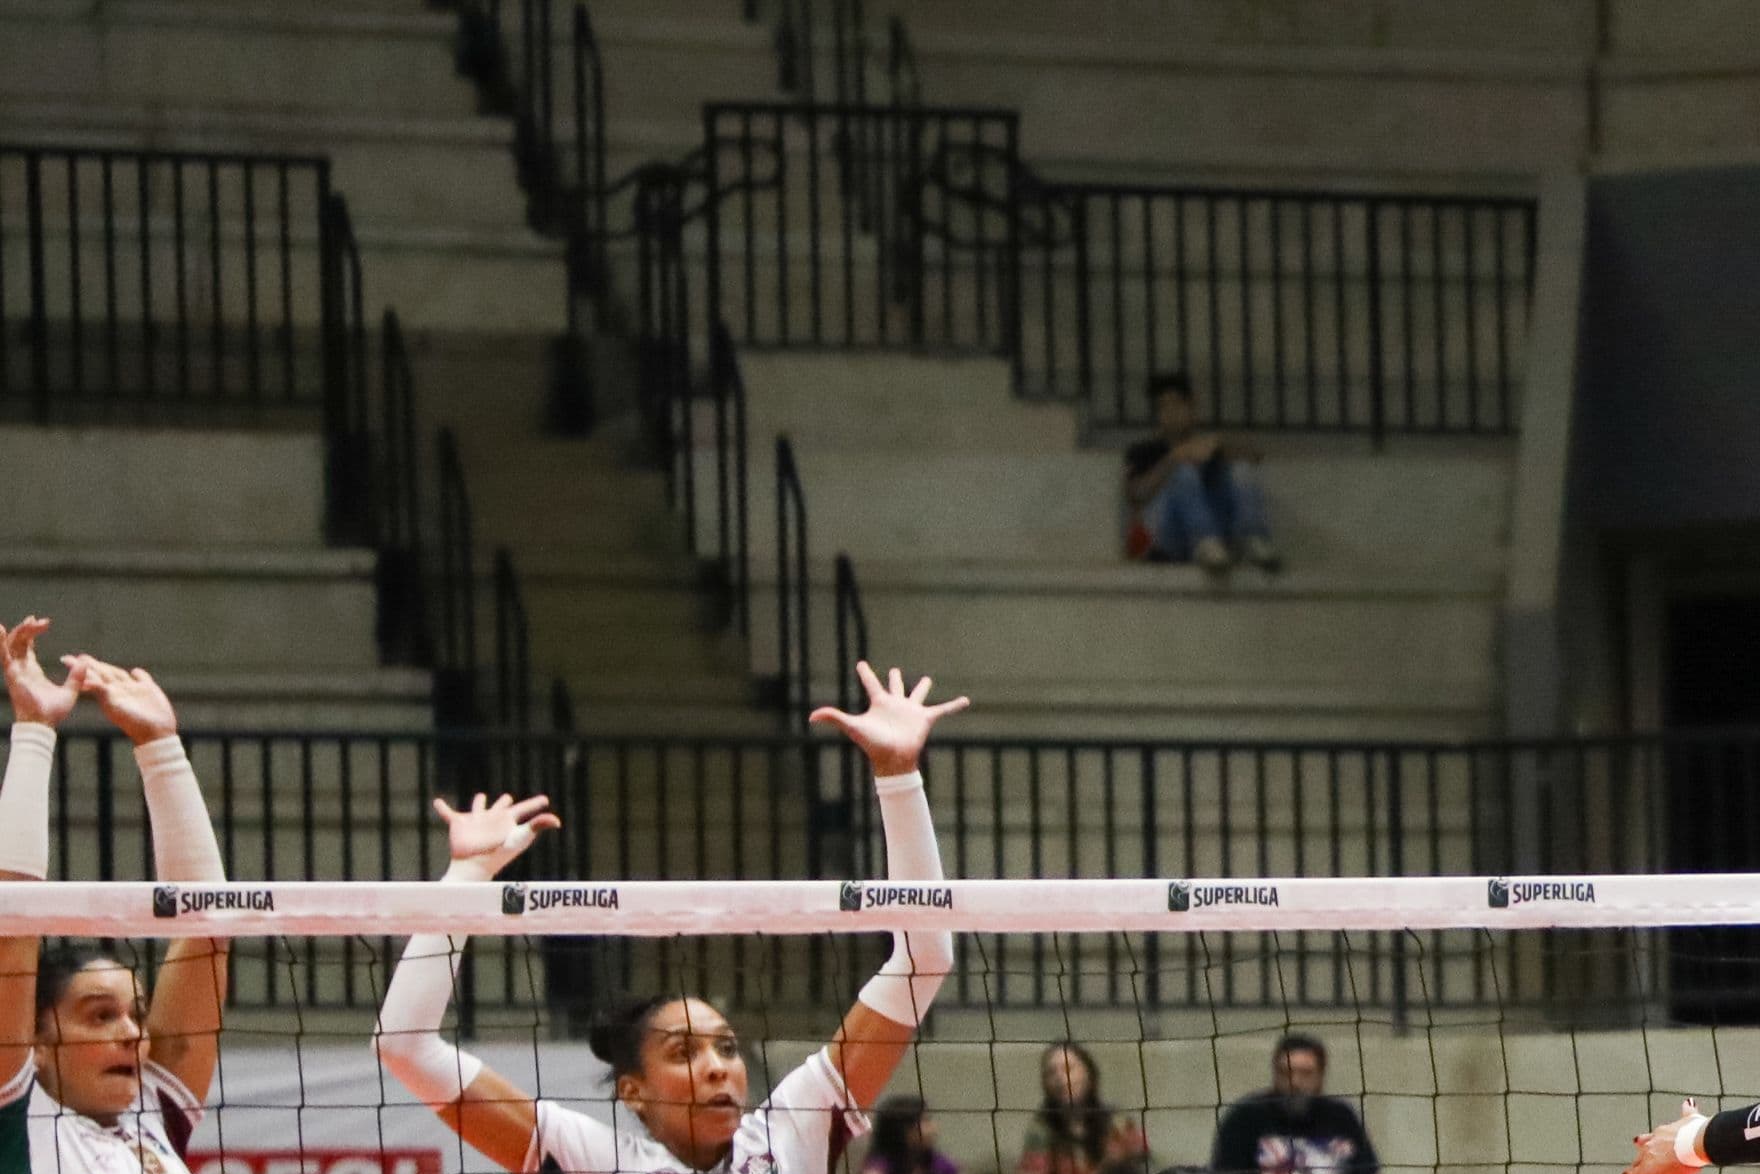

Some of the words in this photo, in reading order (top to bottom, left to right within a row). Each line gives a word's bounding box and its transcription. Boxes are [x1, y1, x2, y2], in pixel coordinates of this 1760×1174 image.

[180, 889, 275, 913] SUPERLIGA
[529, 887, 619, 911] SUPERLIGA
[865, 886, 954, 910] SUPERLIGA
[1193, 886, 1280, 908] SUPERLIGA
[1512, 881, 1596, 904] SUPERLIGA
